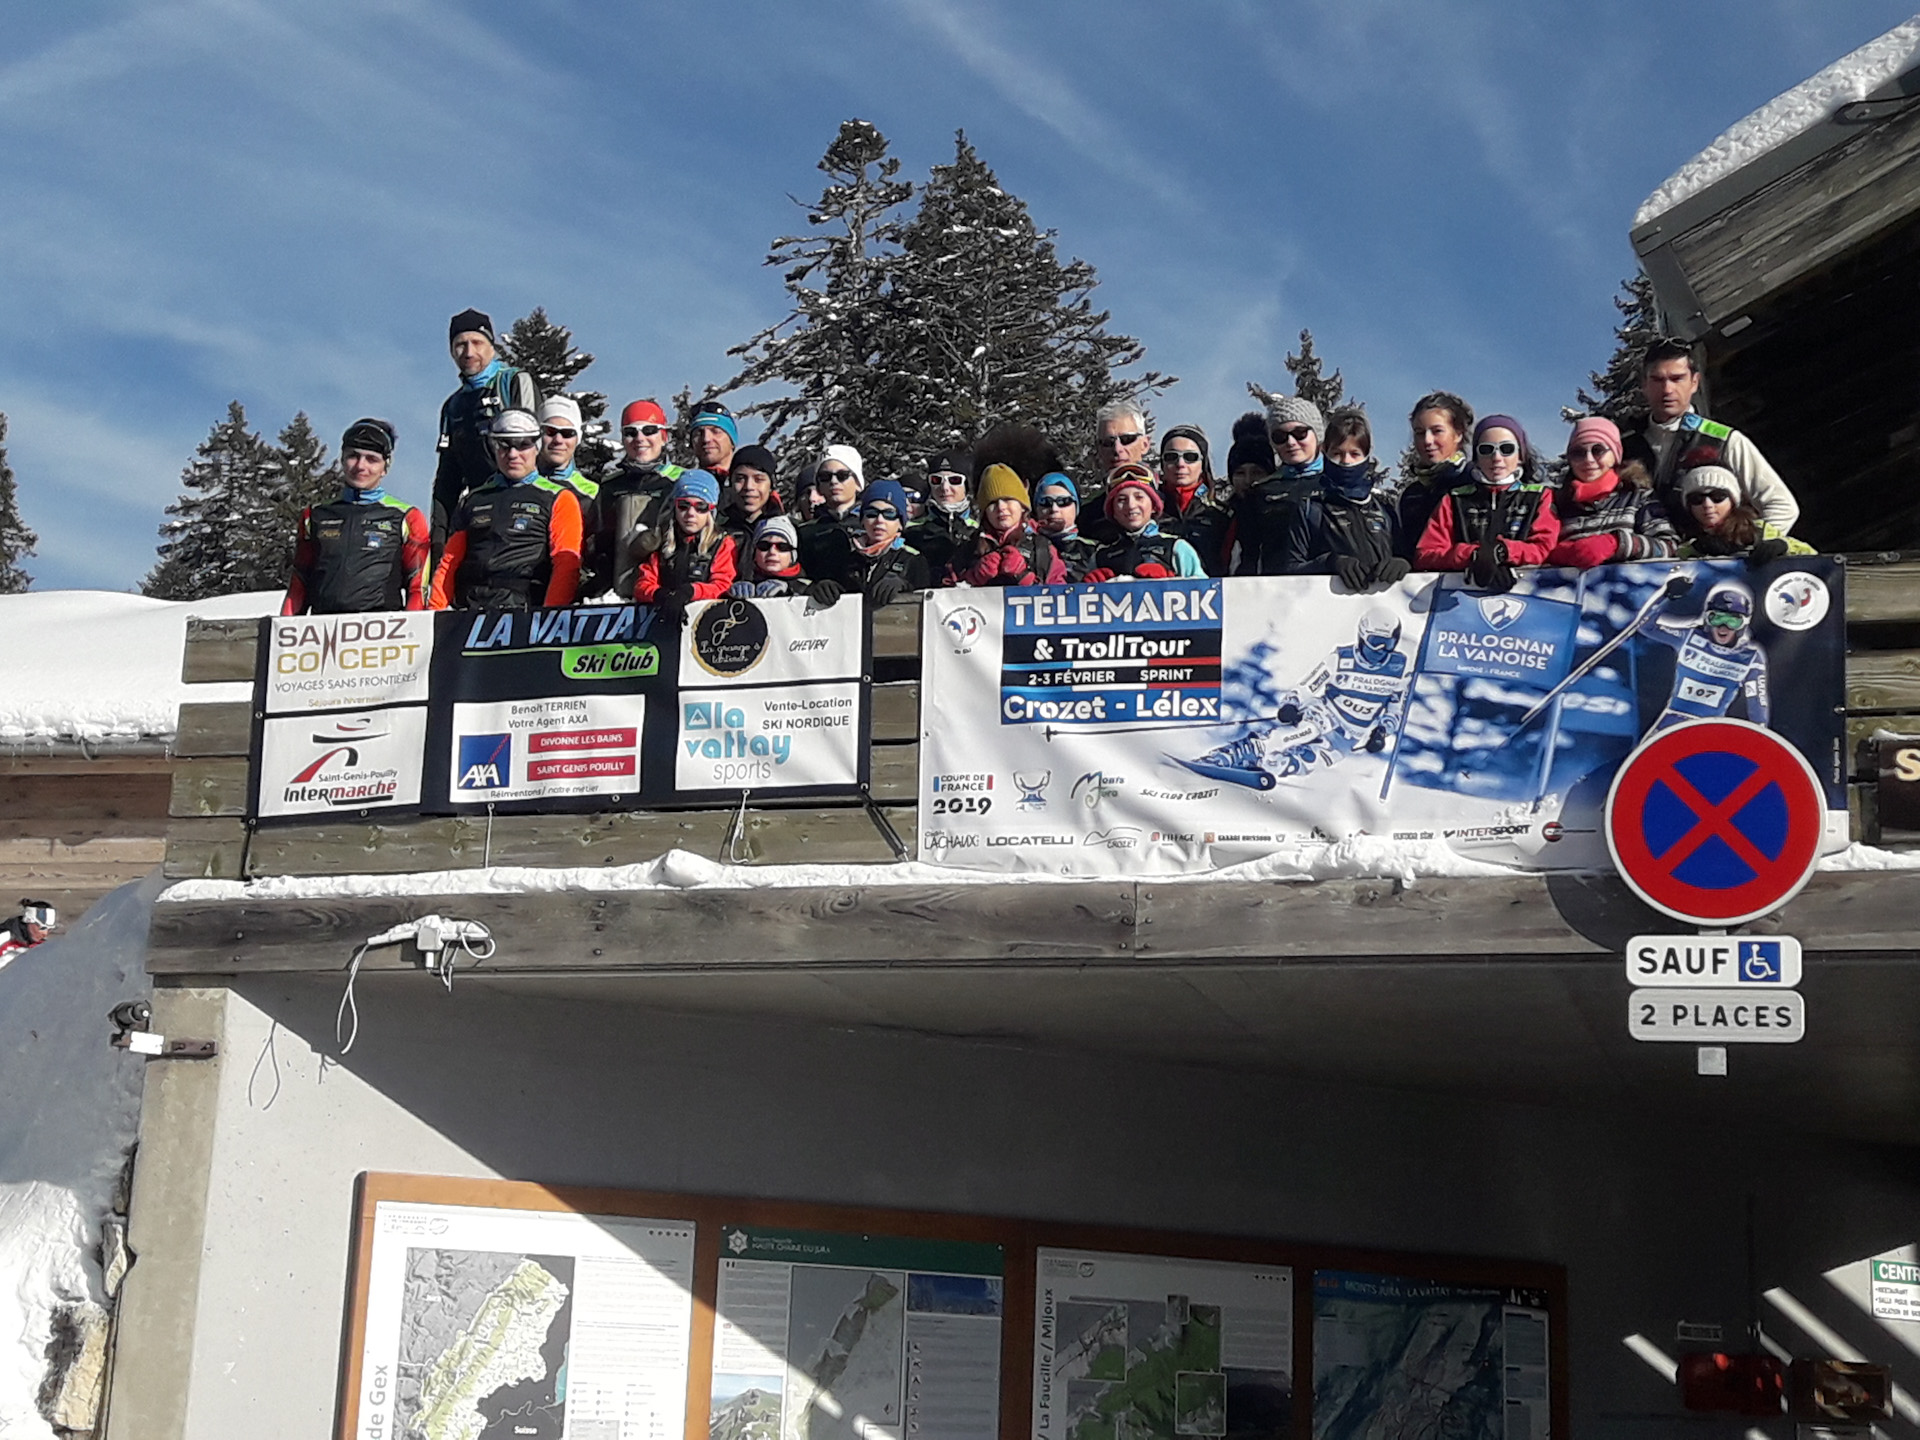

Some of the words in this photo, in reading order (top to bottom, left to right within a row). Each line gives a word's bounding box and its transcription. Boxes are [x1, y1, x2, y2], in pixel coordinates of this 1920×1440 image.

[1008, 587, 1219, 626] TÉLÉMARK
[465, 613, 513, 648] LA
[529, 604, 657, 645] VATTAY
[789, 638, 829, 652] CHEVRY
[1033, 639, 1054, 661] &
[1061, 634, 1191, 660] TrollTour
[1437, 631, 1555, 656] PRALOGNAN
[573, 653, 607, 673] Ski
[610, 650, 655, 672] Club
[1438, 644, 1459, 659] LA
[1464, 646, 1548, 670] VANOISE
[1028, 673, 1051, 686] 2-3
[1054, 669, 1116, 685] FÉVRIER
[1140, 668, 1194, 682] SPRINT
[275, 679, 324, 693] VOYAGES
[327, 677, 357, 689] SANS
[1686, 686, 1717, 698] 107
[545, 700, 587, 712] TERRIEN
[764, 698, 853, 713] Vente-Location
[1003, 695, 1105, 720] Crozet
[1136, 690, 1219, 719] Lélex
[508, 718, 535, 729] Votre
[537, 717, 566, 728] Agent
[568, 715, 589, 725] AXA
[762, 719, 783, 730] SKI
[786, 716, 850, 731] NORDIQUE
[581, 735, 596, 744] LES
[685, 730, 791, 765] vattay
[458, 763, 501, 787] AXA
[537, 764, 561, 775] SAINT
[713, 757, 771, 784] sports
[941, 774, 971, 782] COUPE
[941, 782, 985, 793] FRANCE
[933, 796, 992, 815] 2019
[1456, 824, 1532, 838] INTERSPORT
[986, 835, 1074, 847] LOCATELLI
[1638, 947, 1729, 975] SAUF
[1640, 1004, 1656, 1026] 2
[1673, 1004, 1792, 1028] PLACES
[1041, 1288, 1055, 1339] Mijoux
[369, 1364, 389, 1406] Gex
[1040, 1354, 1052, 1409] Faucille
[513, 1425, 538, 1435] Suisse
